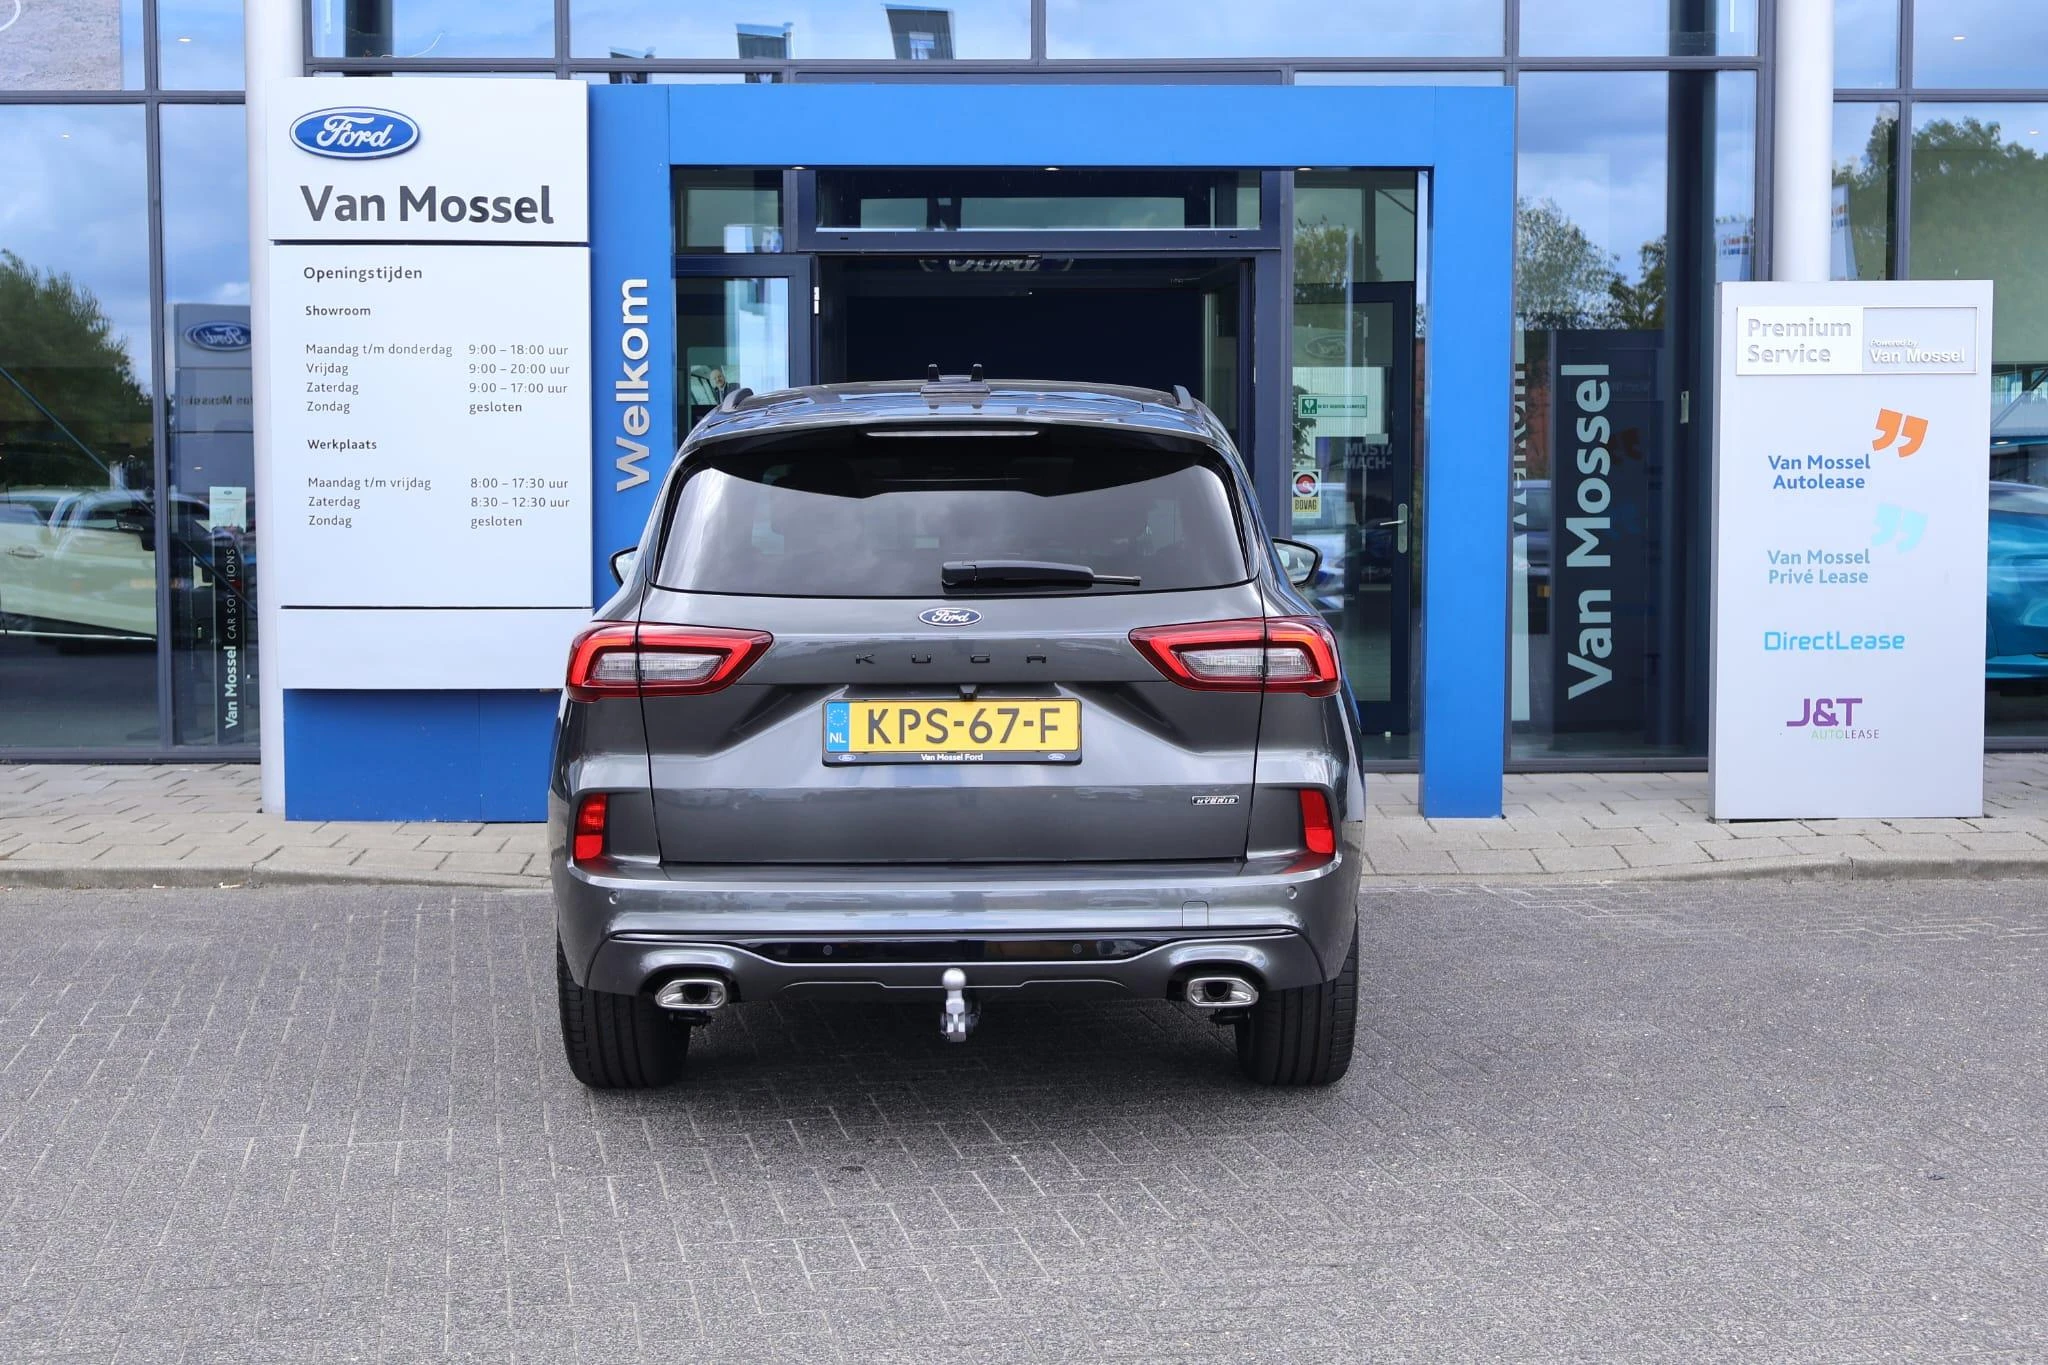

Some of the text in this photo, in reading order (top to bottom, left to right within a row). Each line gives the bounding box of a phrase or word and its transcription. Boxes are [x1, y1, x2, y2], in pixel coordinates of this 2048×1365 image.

[315, 114, 393, 148] Ford
[300, 184, 554, 224] Van Mossel
[303, 266, 423, 283] Openingstijden
[305, 305, 372, 316] Showroom
[1747, 317, 1852, 337] Premium
[306, 343, 359, 357] Maandag
[363, 344, 385, 355] t/m
[388, 344, 453, 357] donderdag
[468, 344, 497, 355] 9:00
[511, 344, 545, 355] 18:00
[548, 346, 569, 355] uur
[1747, 344, 1832, 363] Service
[1870, 347, 1965, 363] Van Mossel
[306, 363, 349, 376] Vrijdag
[469, 363, 497, 374] 9:00
[510, 364, 546, 374] 20:00
[549, 365, 570, 374] uur
[306, 382, 359, 395] Zaterdag
[469, 382, 497, 393] 9:00
[511, 383, 544, 393] 17:00
[548, 384, 568, 393] uur
[615, 278, 651, 492] Welkom
[307, 401, 522, 415] Zondag gesloten
[307, 439, 377, 452] Werkplaats
[1768, 453, 1871, 470] Van Mossel
[308, 477, 361, 491] Maandag
[365, 477, 387, 488] t/m
[390, 477, 432, 491] vrijdag
[470, 478, 498, 488] 8:00
[512, 478, 545, 488] 17:30
[548, 480, 569, 489] uur
[1773, 474, 1865, 489] Autolease
[308, 496, 361, 510] Zaterdag
[470, 497, 498, 508] 8:30
[512, 497, 546, 508] 12:30
[550, 499, 570, 508] uur
[1295, 499, 1317, 510] BOVAG
[308, 515, 523, 529] Zondag gesloten
[1560, 364, 1613, 700] Van Mossel
[1767, 549, 1870, 565] Van Mossel
[1768, 568, 1869, 584] Privé Lease
[931, 608, 970, 623] Ford
[227, 617, 237, 640] CAR
[1764, 631, 1906, 650] DirectLease
[855, 654, 1047, 664] KUGA
[223, 646, 237, 698] Mossel
[225, 701, 238, 729] Van
[1786, 697, 1863, 727] J&T
[868, 708, 1061, 744] KPS-67-F
[829, 732, 847, 744] NL
[1811, 729, 1880, 740] AUTOLEASE
[921, 752, 984, 761] Van Mossel Ford
[1196, 797, 1236, 805] HYBRID
